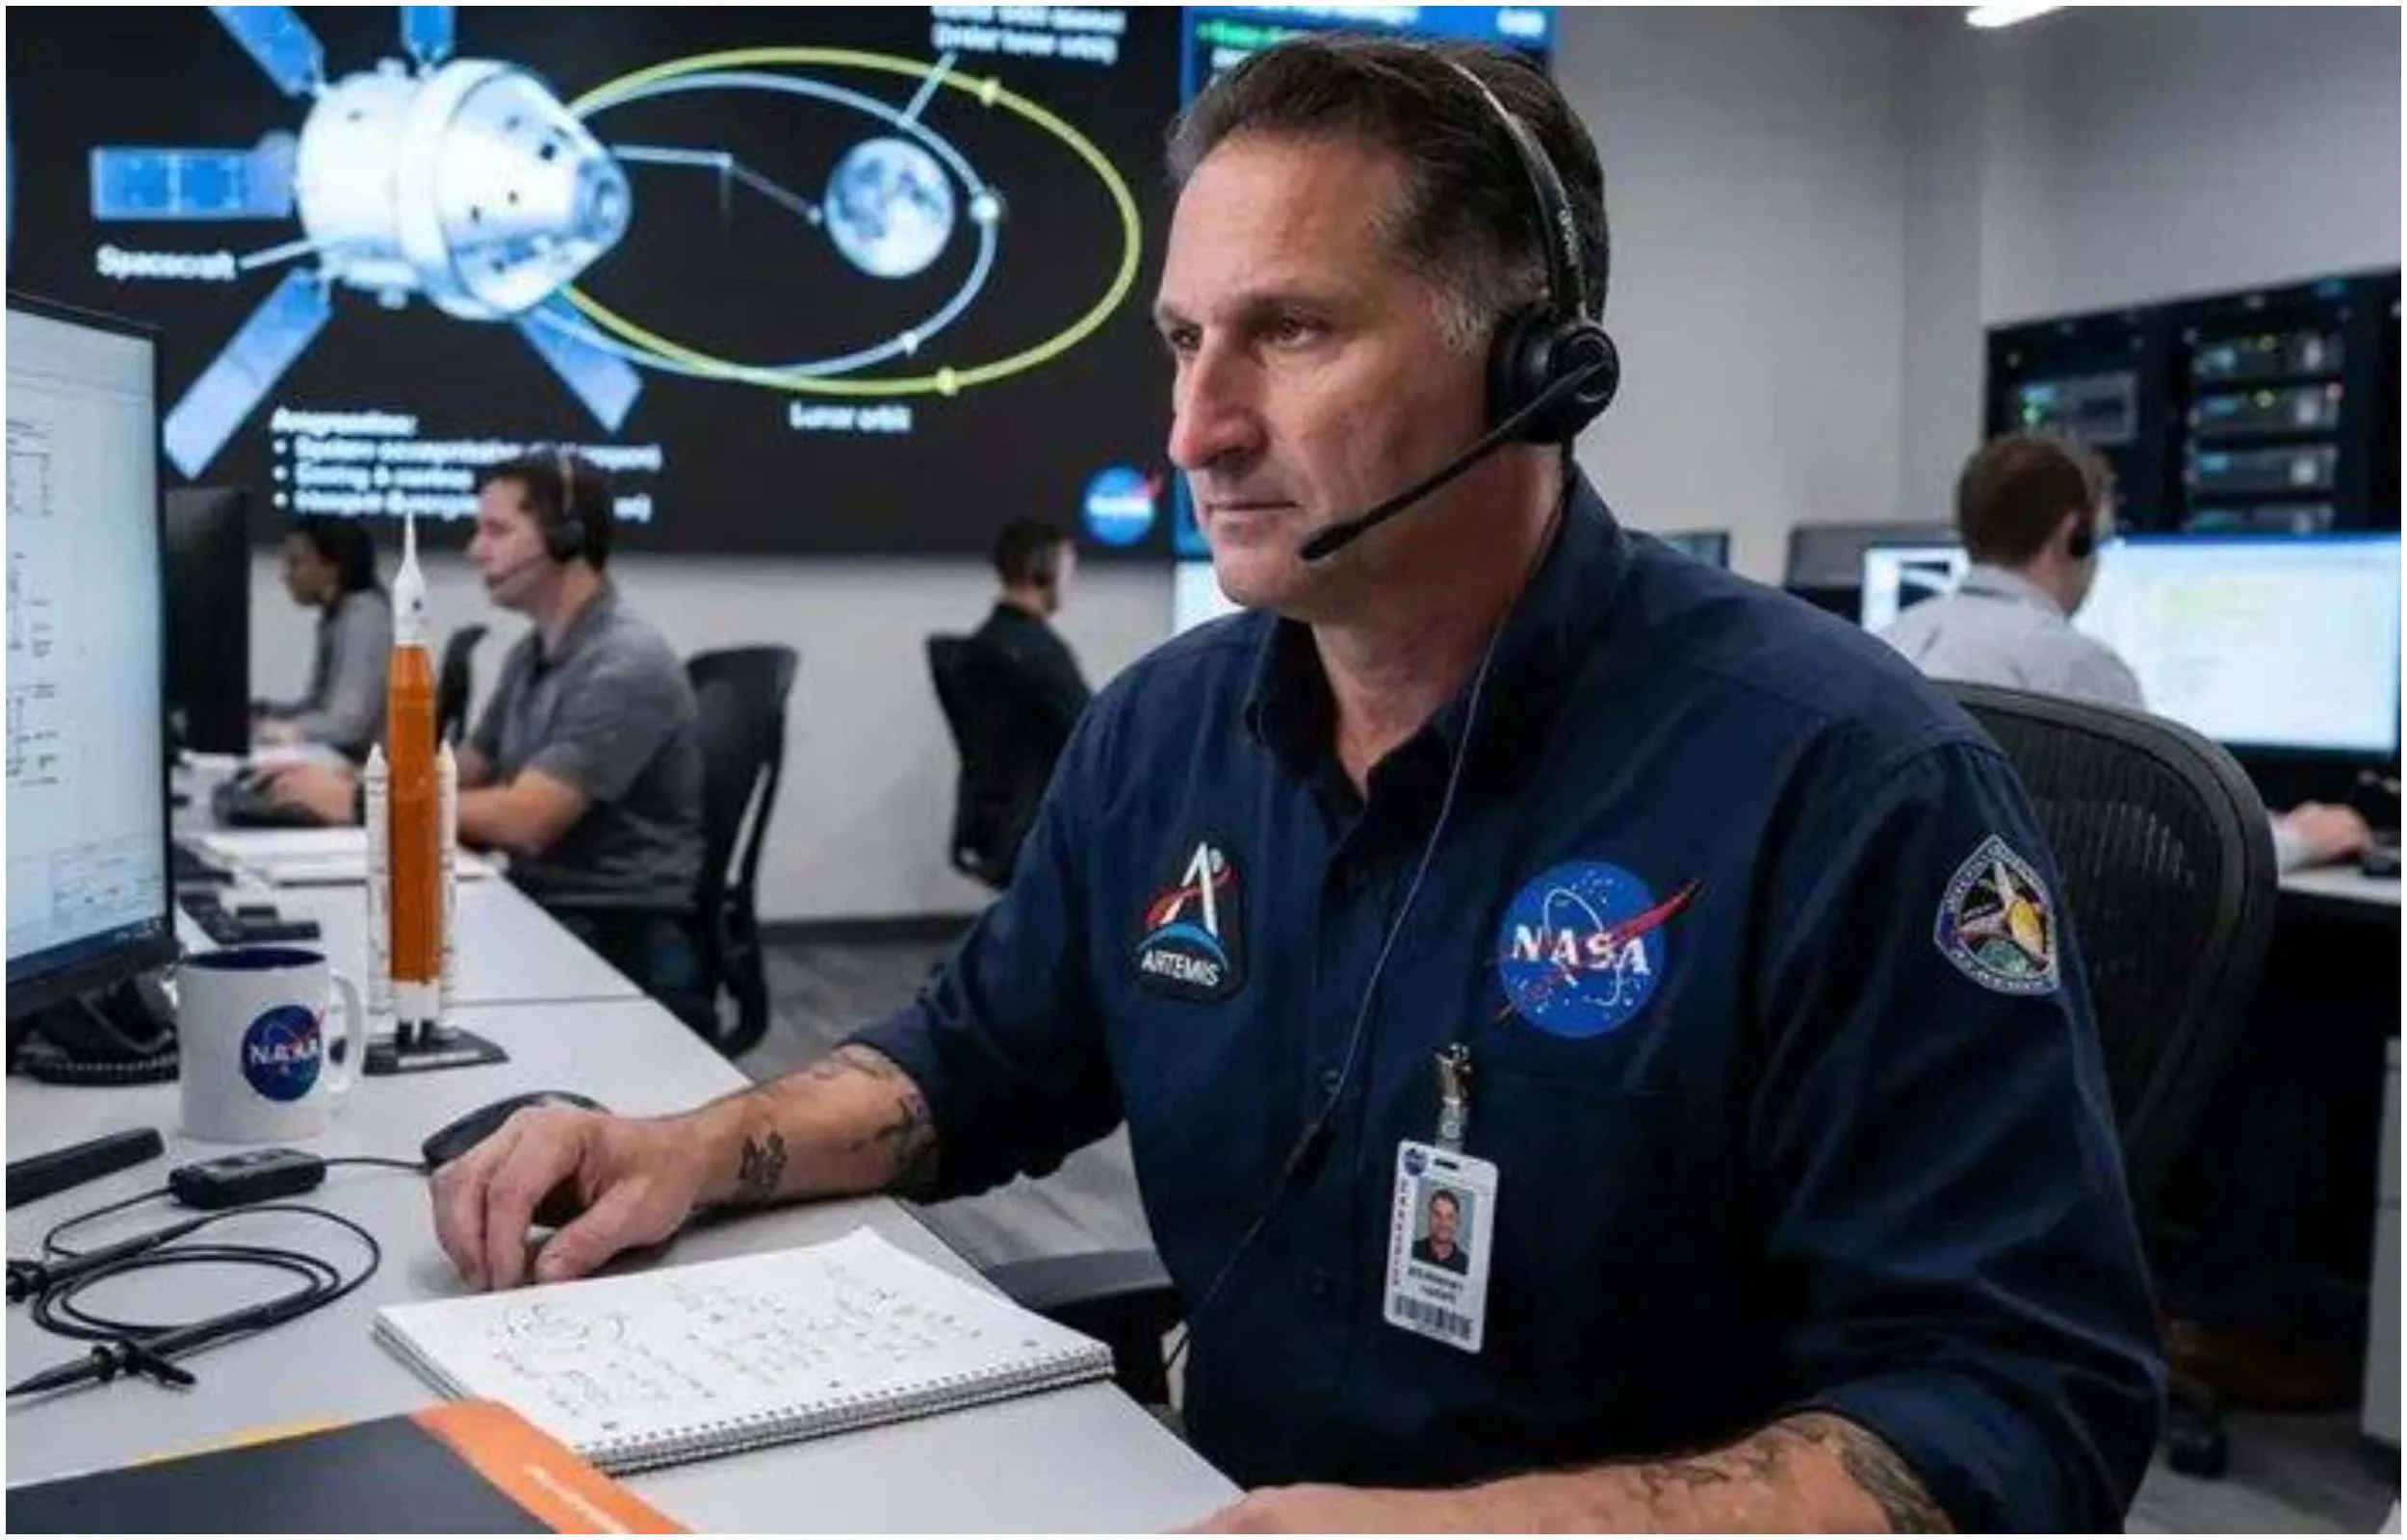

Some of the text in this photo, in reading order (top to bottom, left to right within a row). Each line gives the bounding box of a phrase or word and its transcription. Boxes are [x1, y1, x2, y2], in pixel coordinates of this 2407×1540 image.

[97, 244, 236, 281] Spacecraft
[1513, 925, 1651, 975] NASA
[1142, 950, 1220, 988] ARTEMIS
[248, 1038, 322, 1065] NASA
